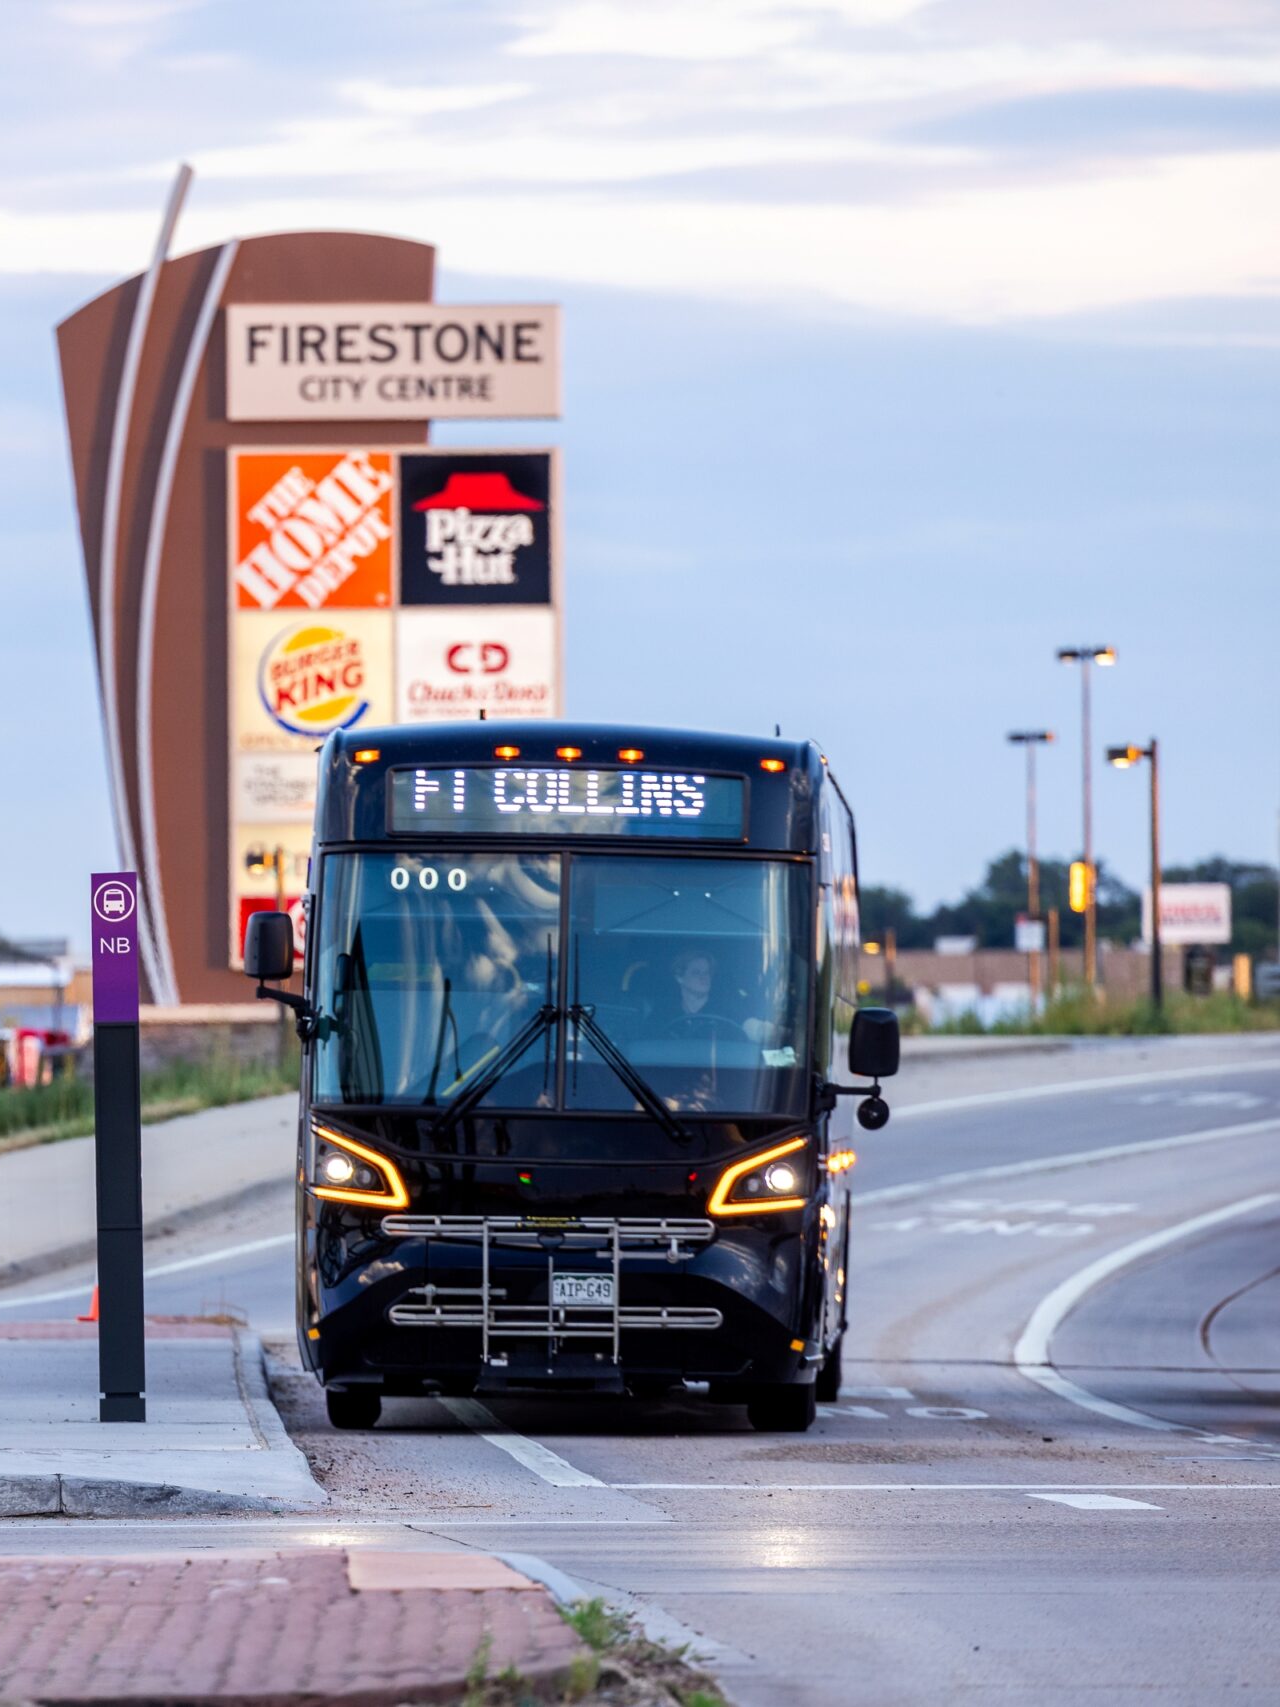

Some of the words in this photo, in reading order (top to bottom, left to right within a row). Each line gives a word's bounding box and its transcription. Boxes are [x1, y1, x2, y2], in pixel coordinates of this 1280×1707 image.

[246, 322, 541, 365] FIRESTONE
[299, 374, 365, 401] CITY
[377, 374, 495, 401] CENTRE
[247, 465, 317, 531] THE
[234, 449, 393, 610] HOME
[426, 506, 534, 552] Pizza
[294, 507, 392, 608] DEPOT
[427, 546, 517, 585] Hut
[270, 639, 360, 681] BURGER
[446, 641, 509, 674] CD
[275, 660, 363, 713] KING
[494, 770, 706, 816] COLLINS
[100, 937, 131, 954] NB
